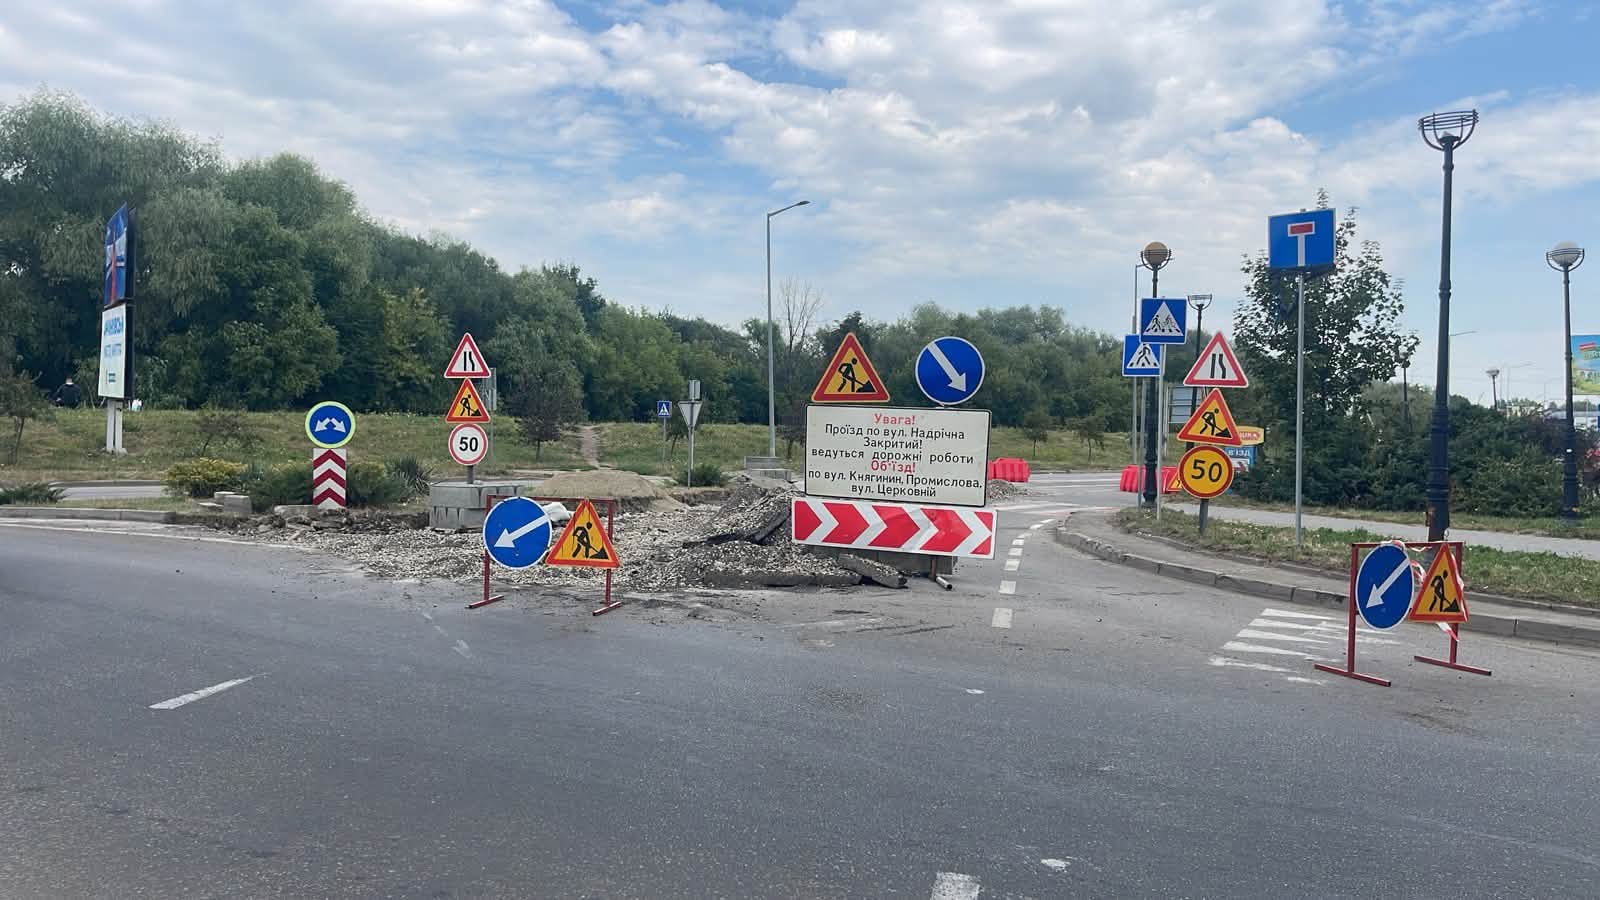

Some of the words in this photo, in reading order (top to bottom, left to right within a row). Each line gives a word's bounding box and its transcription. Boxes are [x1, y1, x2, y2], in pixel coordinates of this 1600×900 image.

[874, 413, 916, 425] Увага!
[825, 423, 863, 436] Проїзд
[866, 427, 880, 436] по
[883, 428, 907, 439] вул.
[910, 427, 965, 440] Надрічна
[459, 436, 479, 452] 50
[863, 436, 923, 450] Закритий!
[811, 448, 864, 459] ведуться
[872, 451, 922, 463] дорожні
[929, 452, 974, 464] роботи
[871, 459, 916, 473] Об'їзд!
[1191, 458, 1223, 483] 50
[808, 470, 821, 479] по
[824, 471, 847, 482] вул.
[849, 470, 904, 485] Княгинин,
[851, 484, 875, 496] вул.
[877, 484, 936, 497] Церковній
